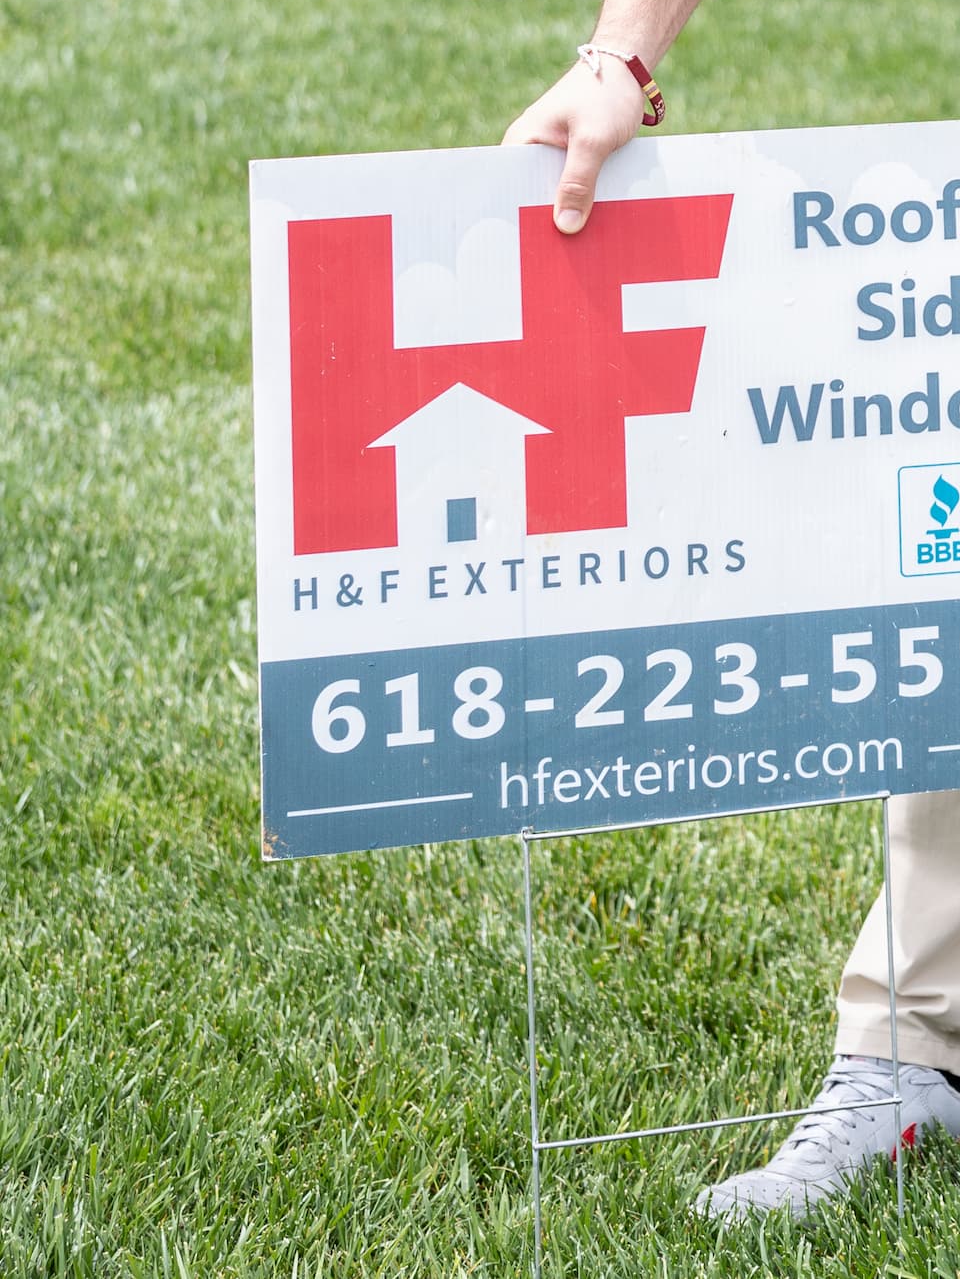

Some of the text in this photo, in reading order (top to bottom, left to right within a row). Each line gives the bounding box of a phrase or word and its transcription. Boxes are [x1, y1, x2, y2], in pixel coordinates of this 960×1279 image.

[288, 195, 734, 555] HF
[294, 539, 746, 611] H&F EXTERIORS
[500, 736, 904, 809] hfexteriors.com
